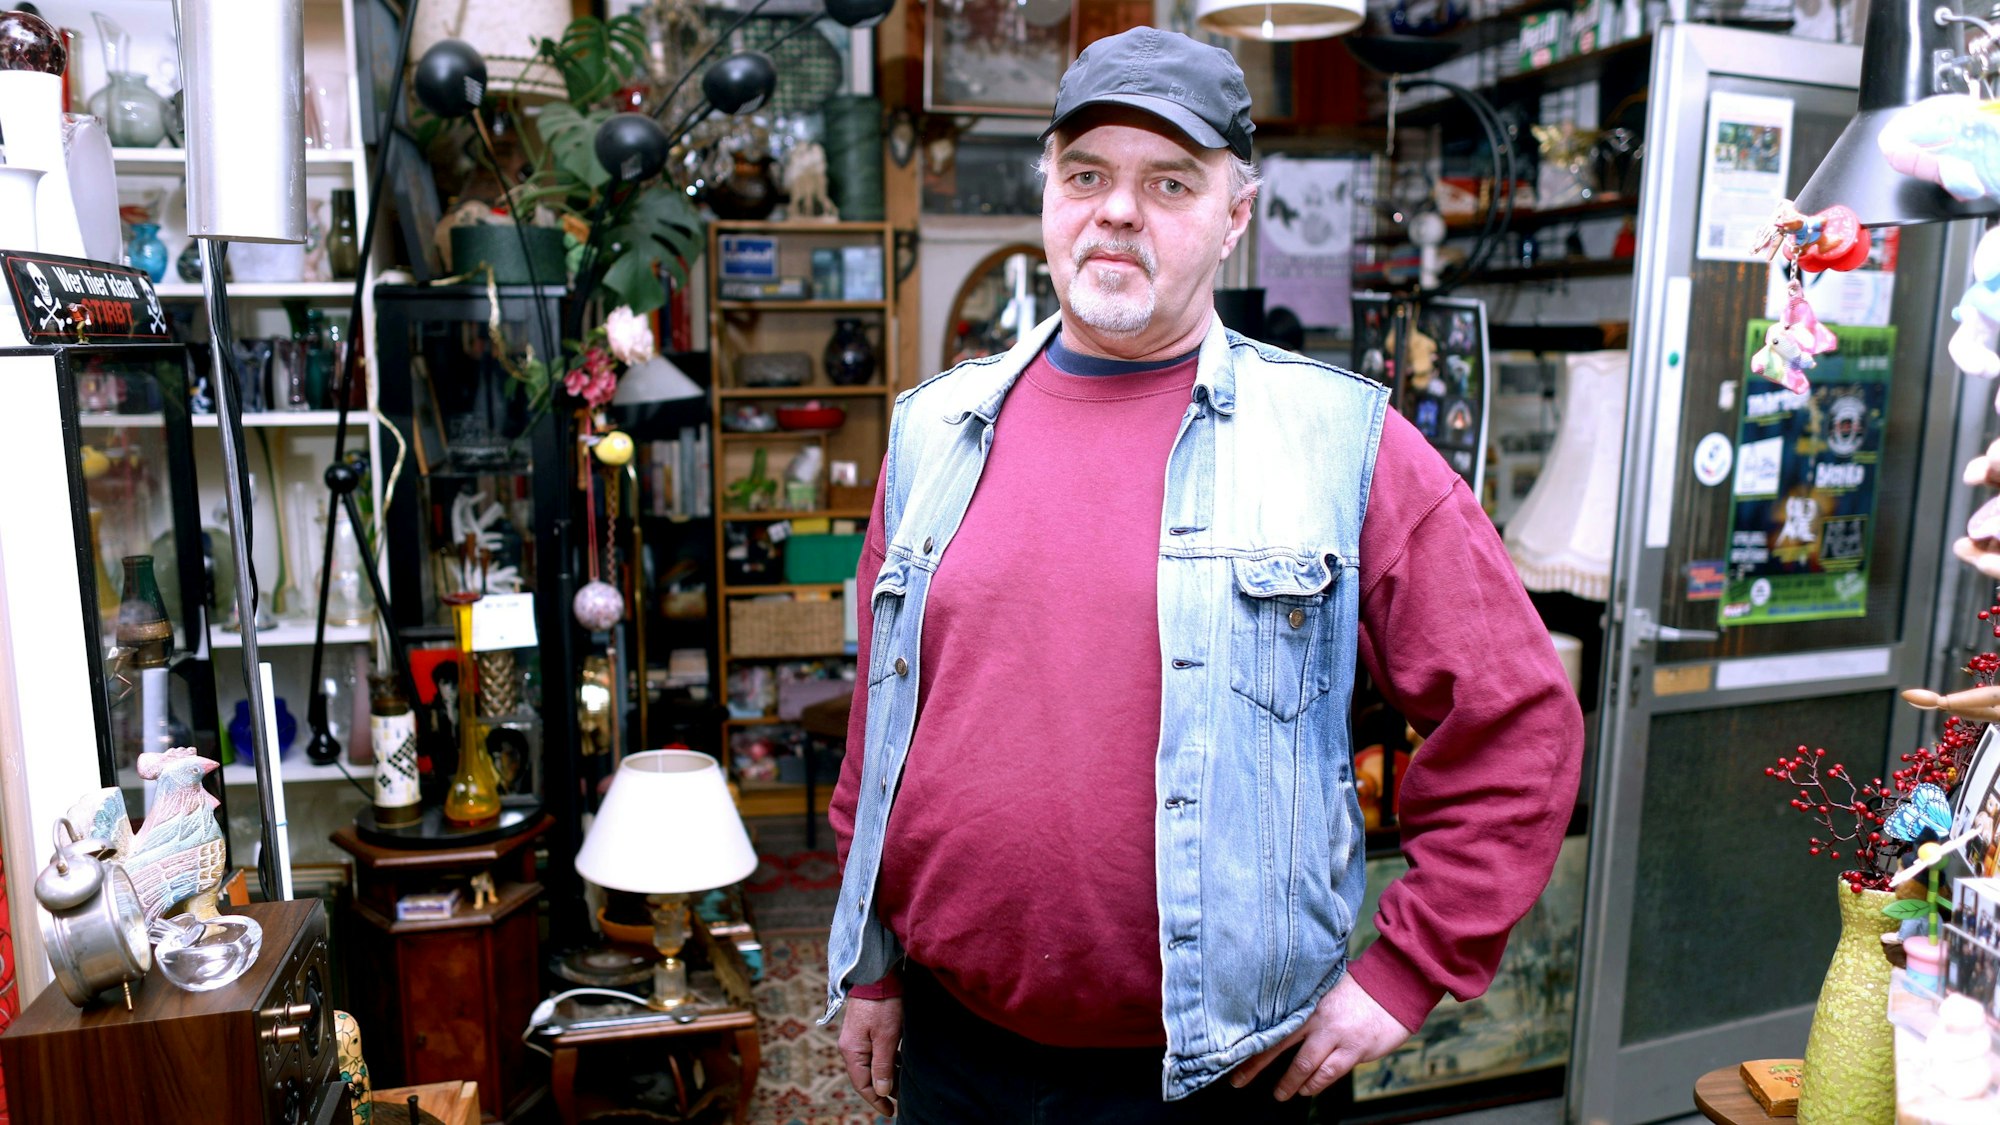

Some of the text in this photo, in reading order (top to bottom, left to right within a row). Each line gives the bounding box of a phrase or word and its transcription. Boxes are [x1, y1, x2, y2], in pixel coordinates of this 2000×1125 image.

[51, 266, 139, 299] Wer hier klaut
[80, 298, 133, 328] STIRBT
